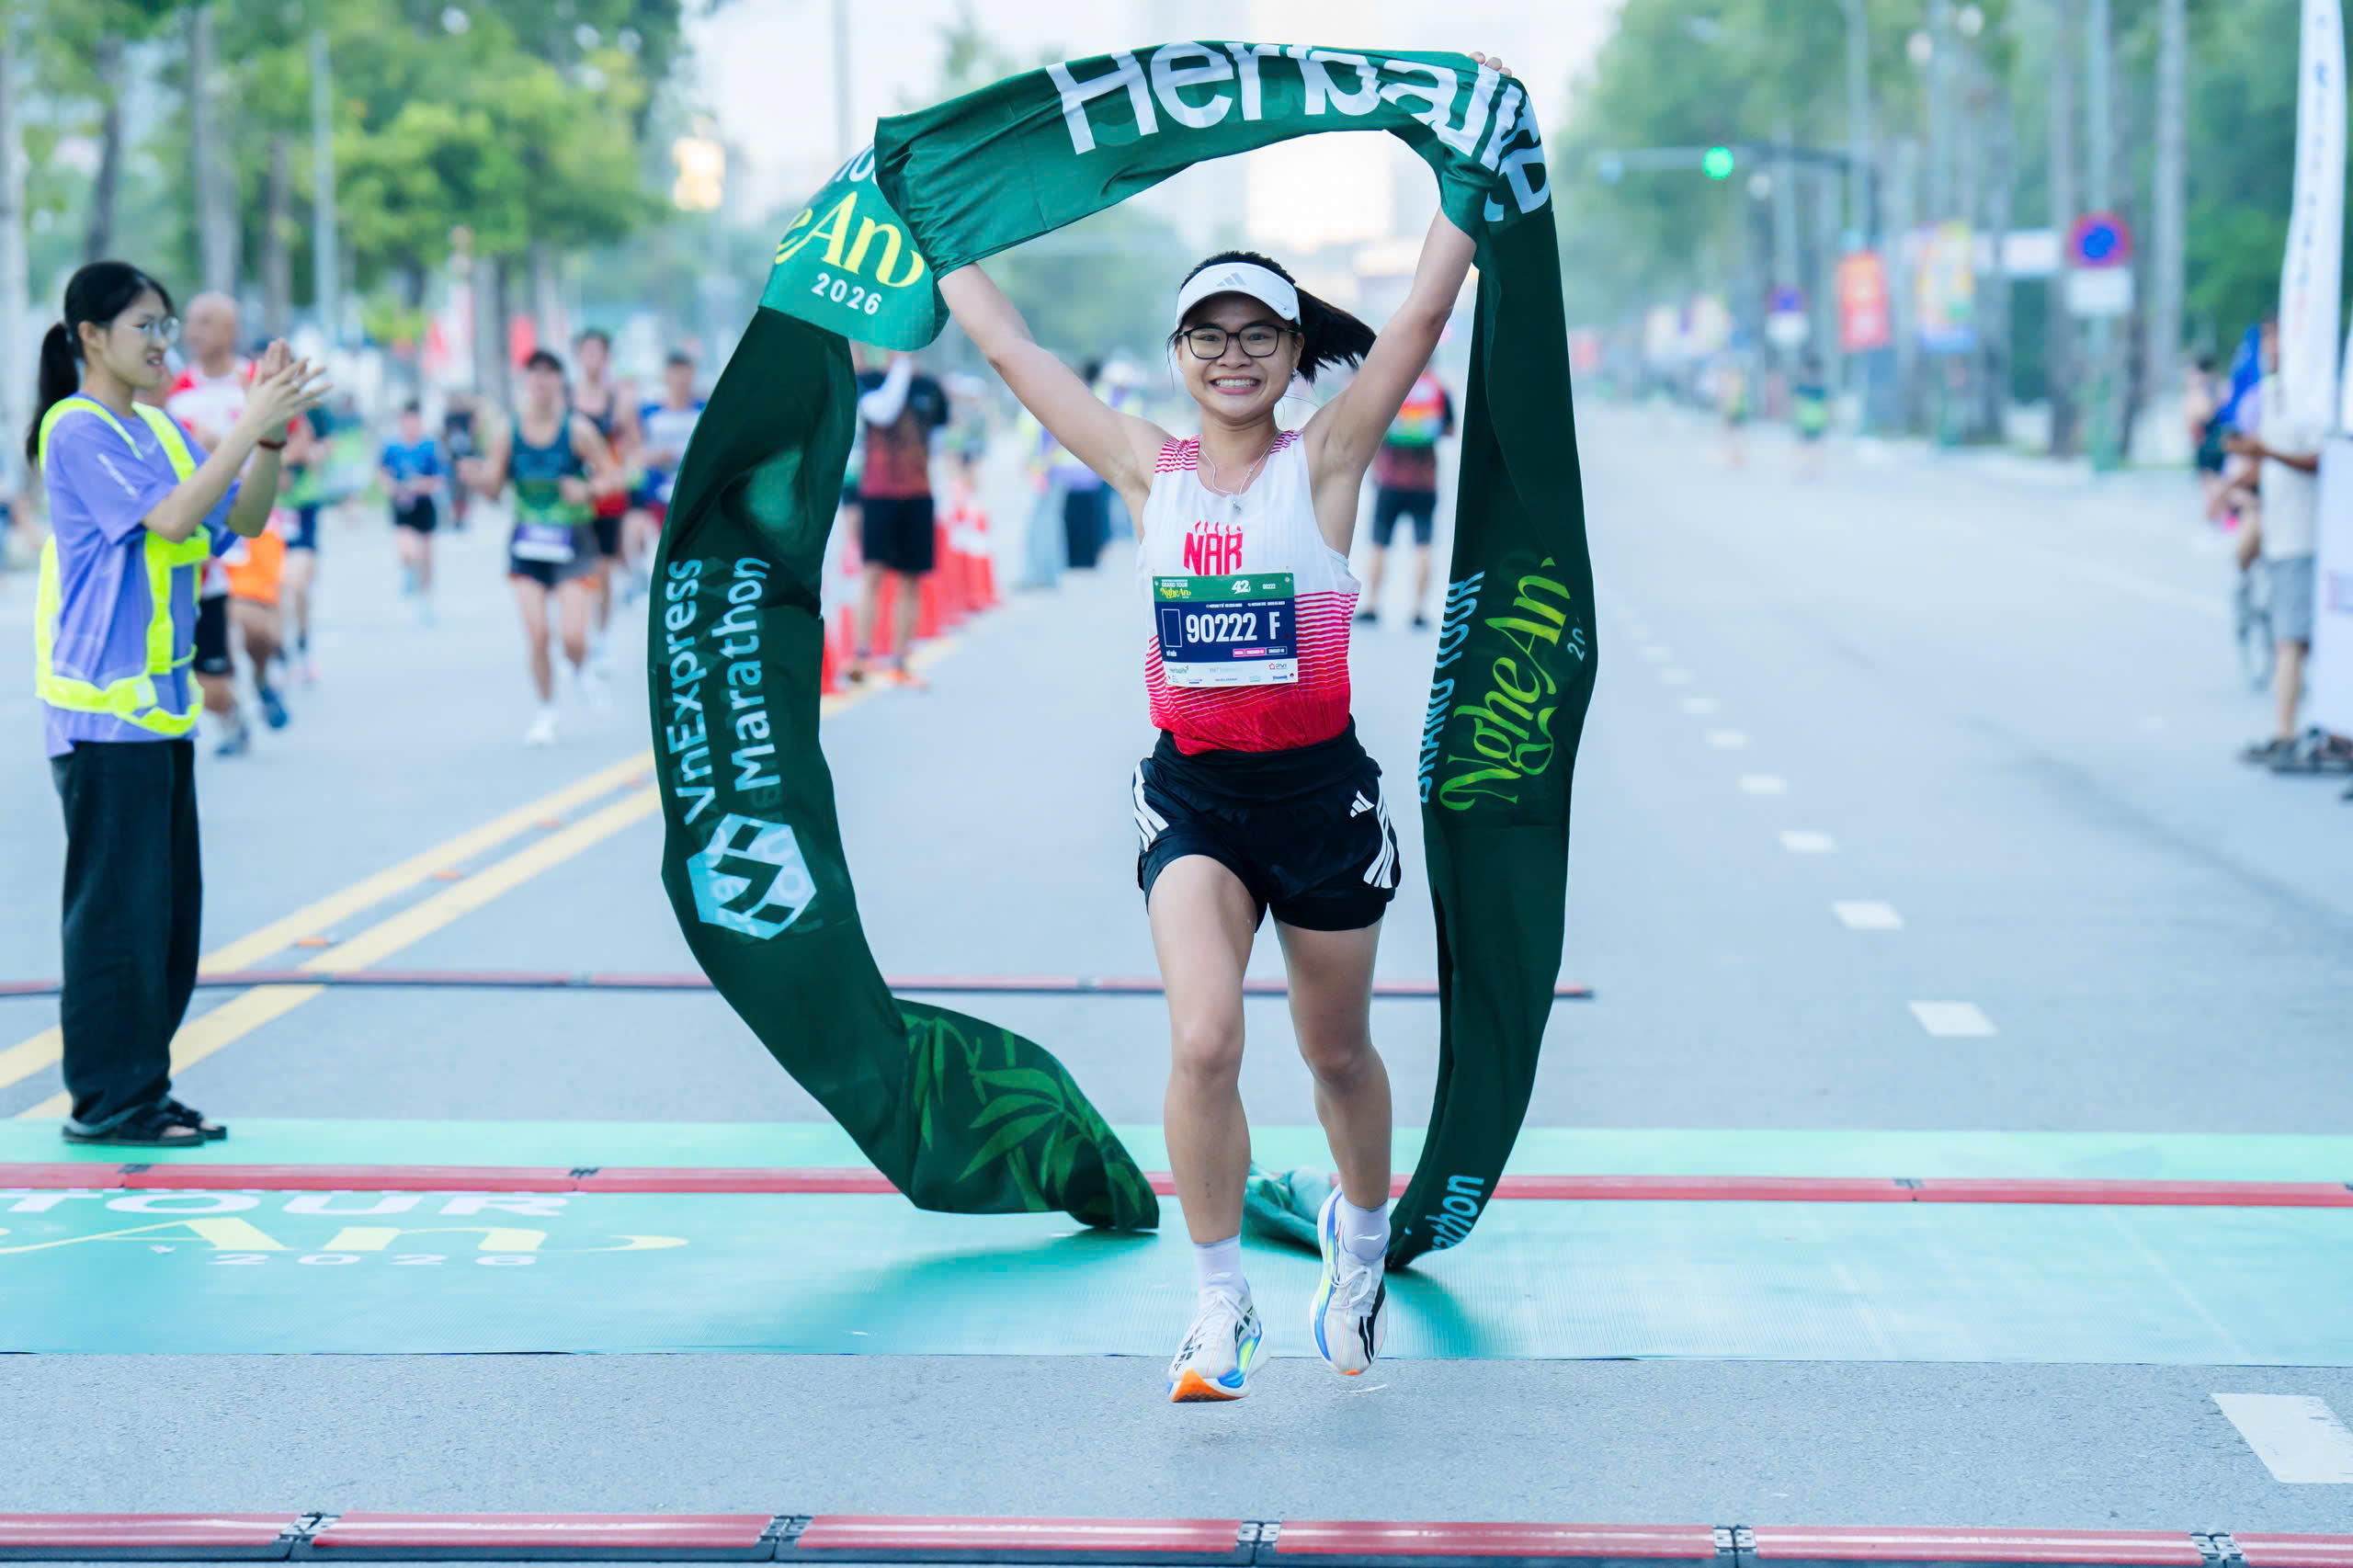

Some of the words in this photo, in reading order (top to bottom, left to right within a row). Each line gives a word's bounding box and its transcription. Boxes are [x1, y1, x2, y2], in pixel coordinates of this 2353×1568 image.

[811, 272, 882, 315] 2026
[1184, 529, 1243, 575] NAR
[1186, 612, 1257, 642] 90222
[1269, 611, 1280, 640] F
[665, 558, 716, 825] VnExpress
[711, 557, 780, 791] Marathon
[0, 1193, 569, 1216] TOUR
[1426, 1175, 1485, 1251] athon
[206, 1253, 537, 1266] 2026
